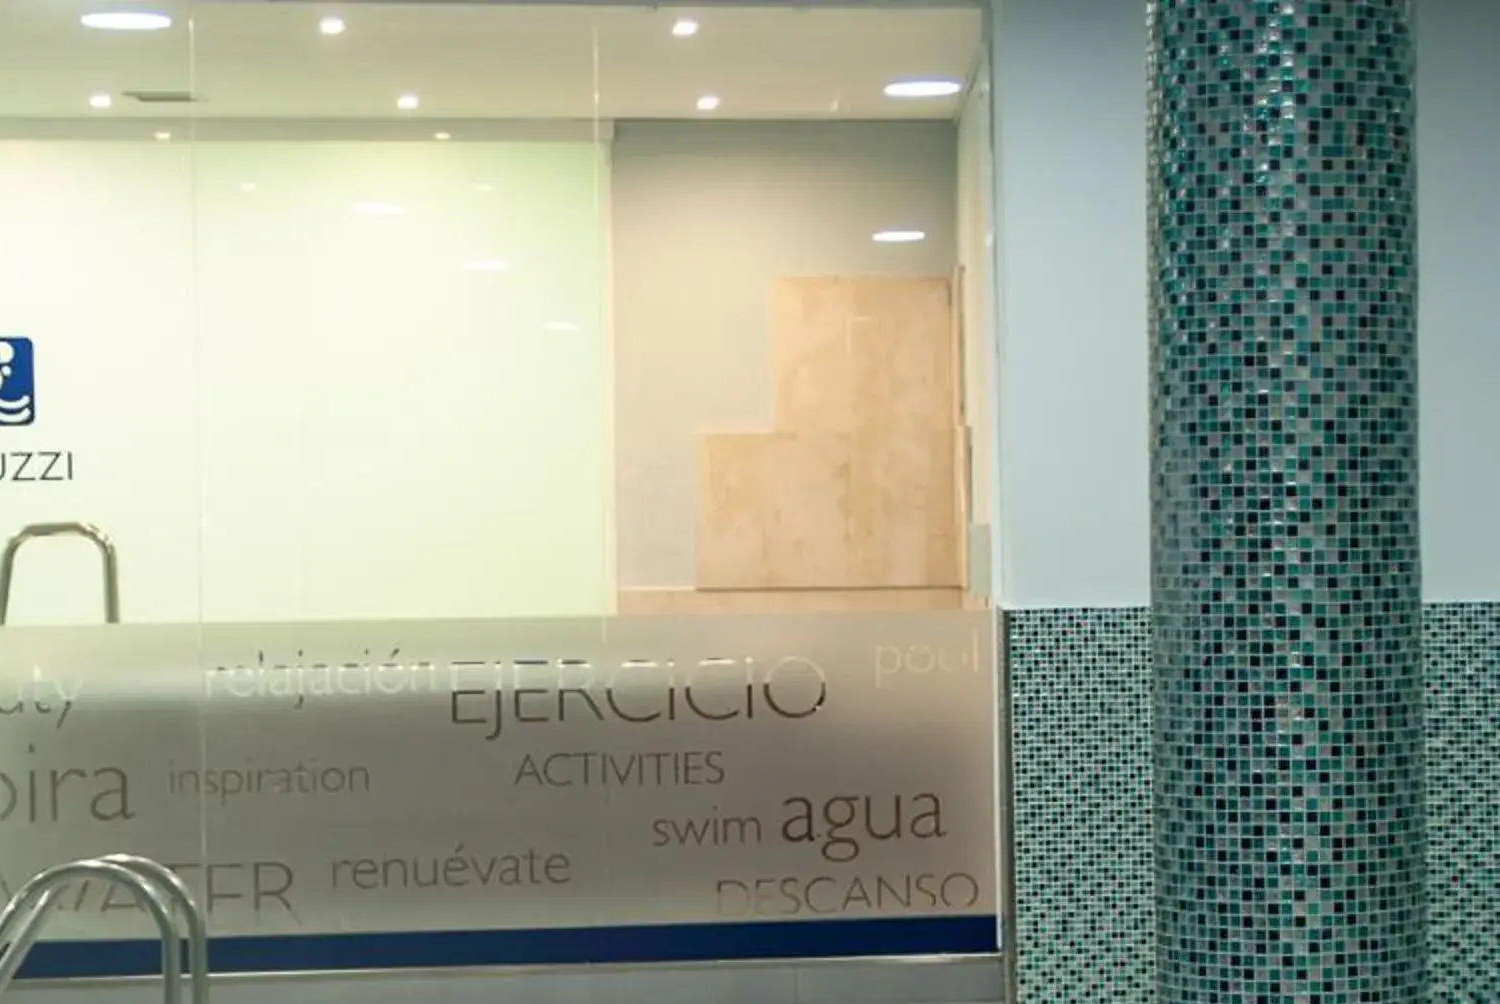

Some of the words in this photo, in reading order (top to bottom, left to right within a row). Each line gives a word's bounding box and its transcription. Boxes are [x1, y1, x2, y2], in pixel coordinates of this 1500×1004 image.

[203, 638, 436, 710] relajación
[450, 654, 827, 742] EJERCICIO
[168, 756, 370, 807] inspiration
[513, 750, 726, 786] ACTIVITIES
[651, 805, 763, 847] swim
[781, 791, 948, 863] agua
[330, 843, 572, 890] renuévate
[715, 871, 980, 915] DESCANSO
